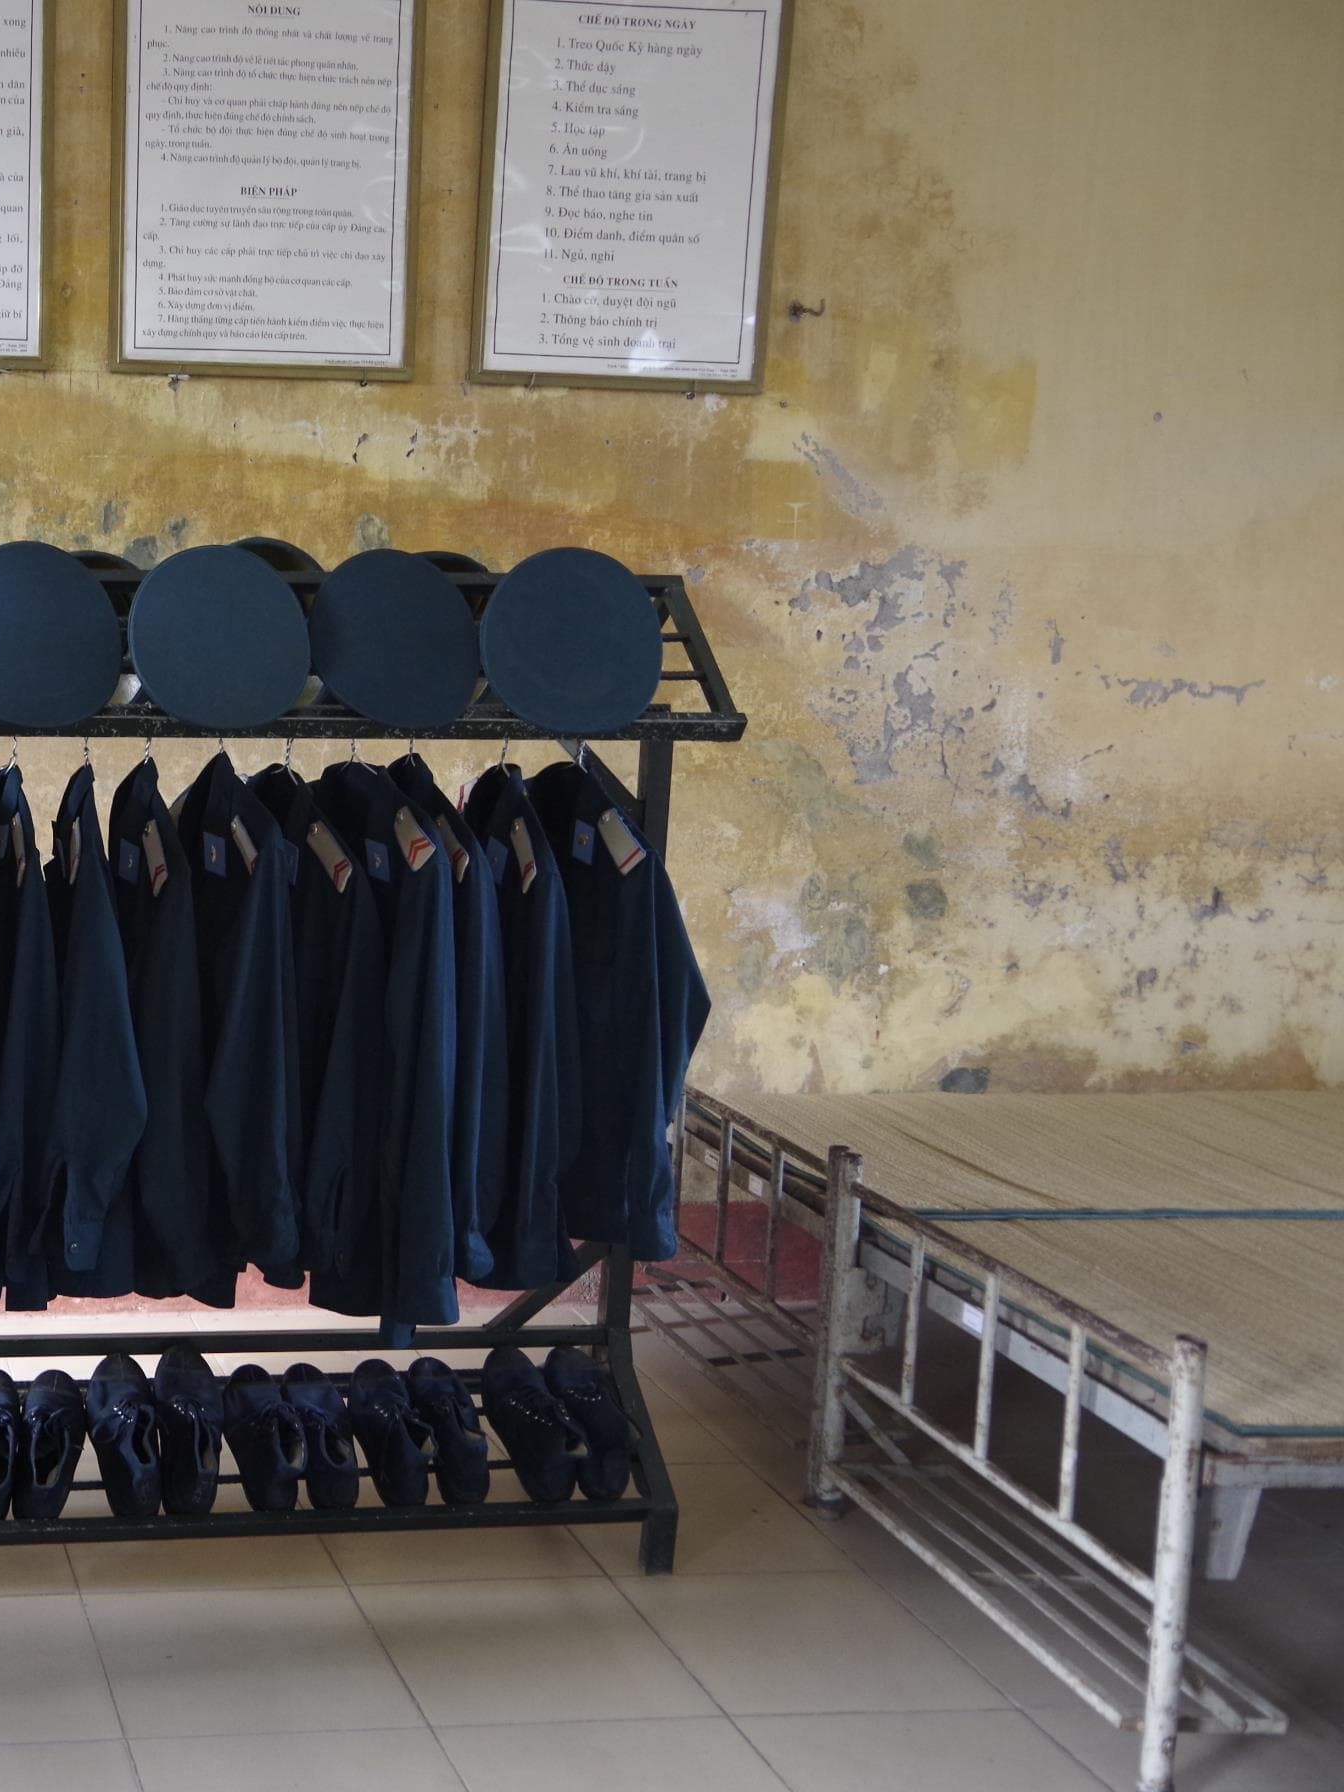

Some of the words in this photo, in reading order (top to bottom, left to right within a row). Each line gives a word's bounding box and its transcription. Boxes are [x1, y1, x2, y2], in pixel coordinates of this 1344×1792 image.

[556, 37, 566, 48] 1.
[554, 58, 565, 69] 2.
[552, 80, 563, 91] 3.
[551, 101, 563, 111] 4.
[550, 122, 562, 134] 5.
[548, 144, 560, 154] 6.
[547, 164, 558, 175] 7.
[545, 185, 557, 196] 8.
[544, 206, 555, 217] 9.
[544, 228, 560, 238] 10.
[158, 245, 168, 254] 3.
[543, 249, 558, 259] 11.
[157, 286, 166, 295] 5.
[541, 293, 551, 303] 1.
[157, 301, 166, 309] 6.
[540, 313, 550, 323] 2.
[538, 333, 549, 344] 3.
